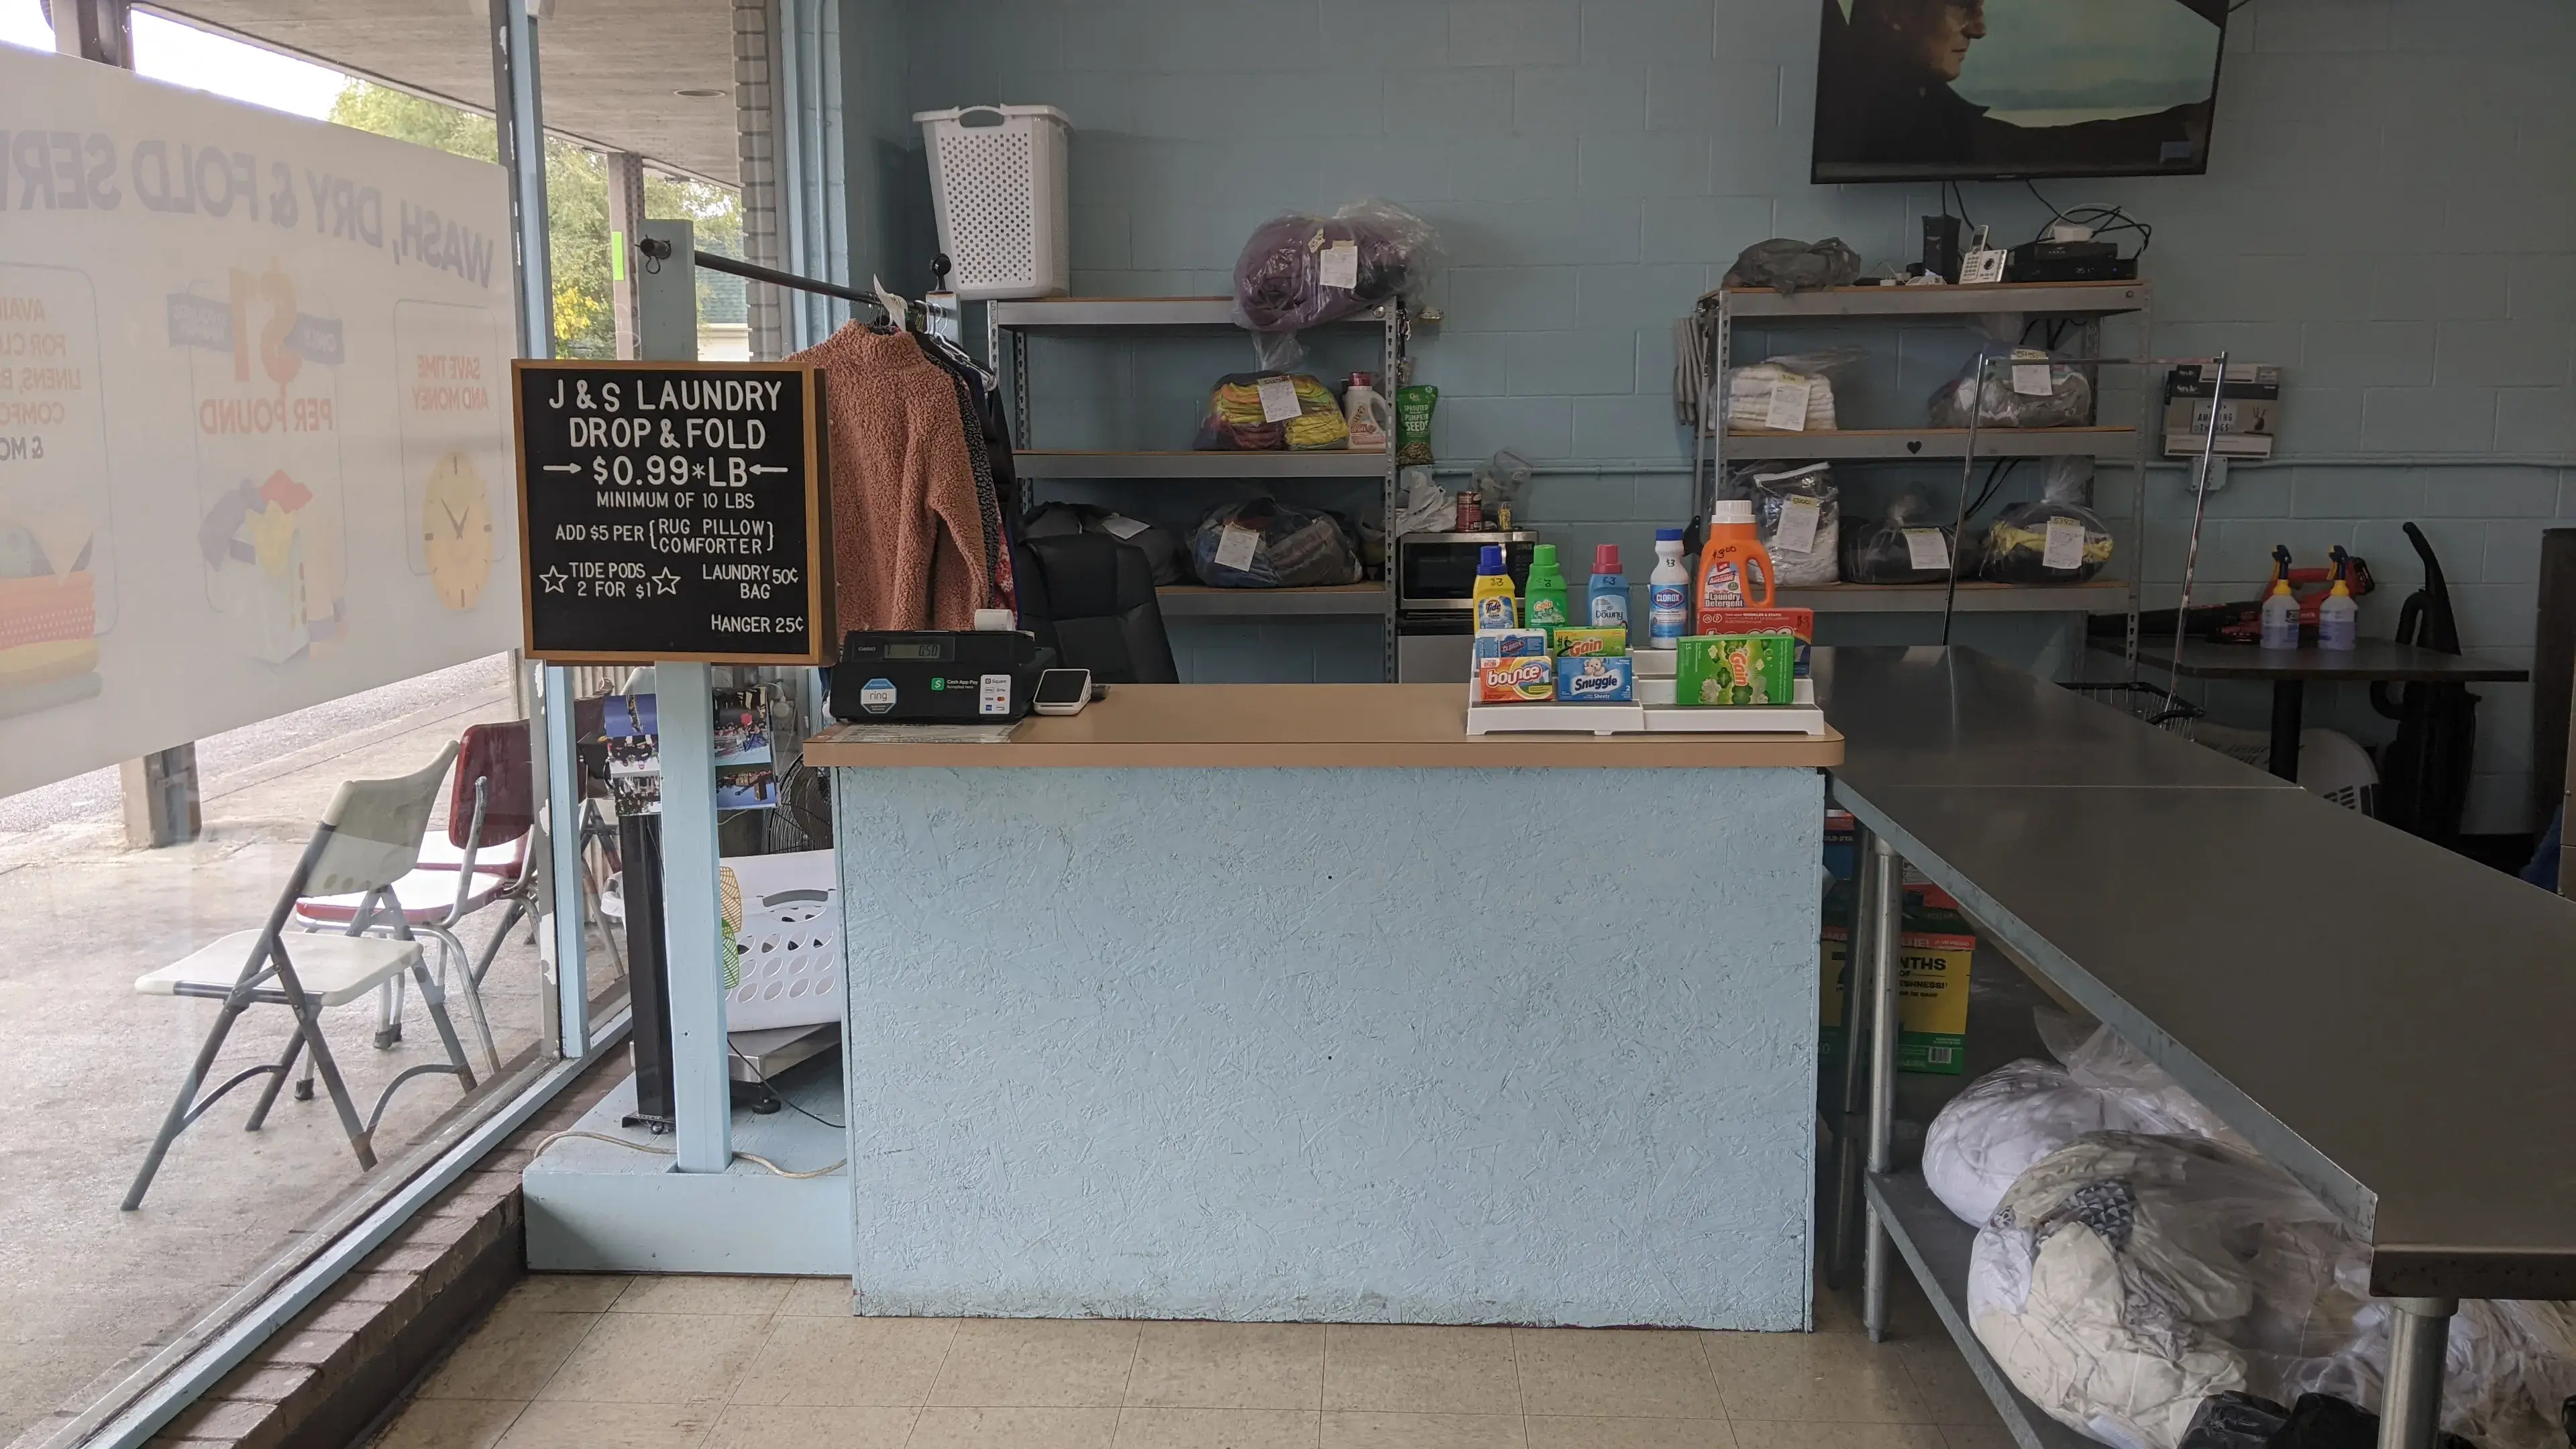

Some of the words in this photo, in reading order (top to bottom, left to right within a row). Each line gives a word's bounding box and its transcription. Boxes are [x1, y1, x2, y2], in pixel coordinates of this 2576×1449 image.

[549, 380, 564, 409] J
[577, 380, 597, 409] &
[602, 383, 620, 412] S
[637, 380, 782, 411] LAUNDRY
[2198, 413, 2233, 421] AMING
[570, 417, 651, 447] DROP
[660, 419, 680, 448] &
[687, 419, 765, 449] FOLD
[598, 492, 668, 508] MINIMUM
[675, 492, 694, 508] OF
[703, 493, 717, 508] 10
[726, 493, 754, 508] LBS
[556, 525, 585, 540] ADD
[590, 525, 608, 540] $5
[614, 525, 644, 541] PER
[659, 519, 690, 535] RUG
[703, 519, 764, 535] PILLOW
[660, 538, 761, 554] COMFORTER
[569, 563, 604, 578] TIDE
[609, 563, 645, 578] PODS
[703, 564, 769, 580] LAUNDRY
[773, 568, 798, 584] 50¢
[578, 581, 586, 596] 2
[596, 582, 625, 596] FOR
[636, 582, 650, 598] $1
[741, 583, 770, 598] BAG
[1710, 593, 1741, 601] Laundry
[1486, 603, 1501, 613] Tide
[1534, 602, 1553, 611] Gain
[712, 614, 770, 632] HANGER
[776, 616, 803, 633] 25¢
[1569, 639, 1602, 657] Gain
[1487, 665, 1541, 686] bounce
[1574, 675, 1617, 691] Snuggle
[870, 691, 888, 702] ring
[1900, 957, 1947, 971] NTHS
